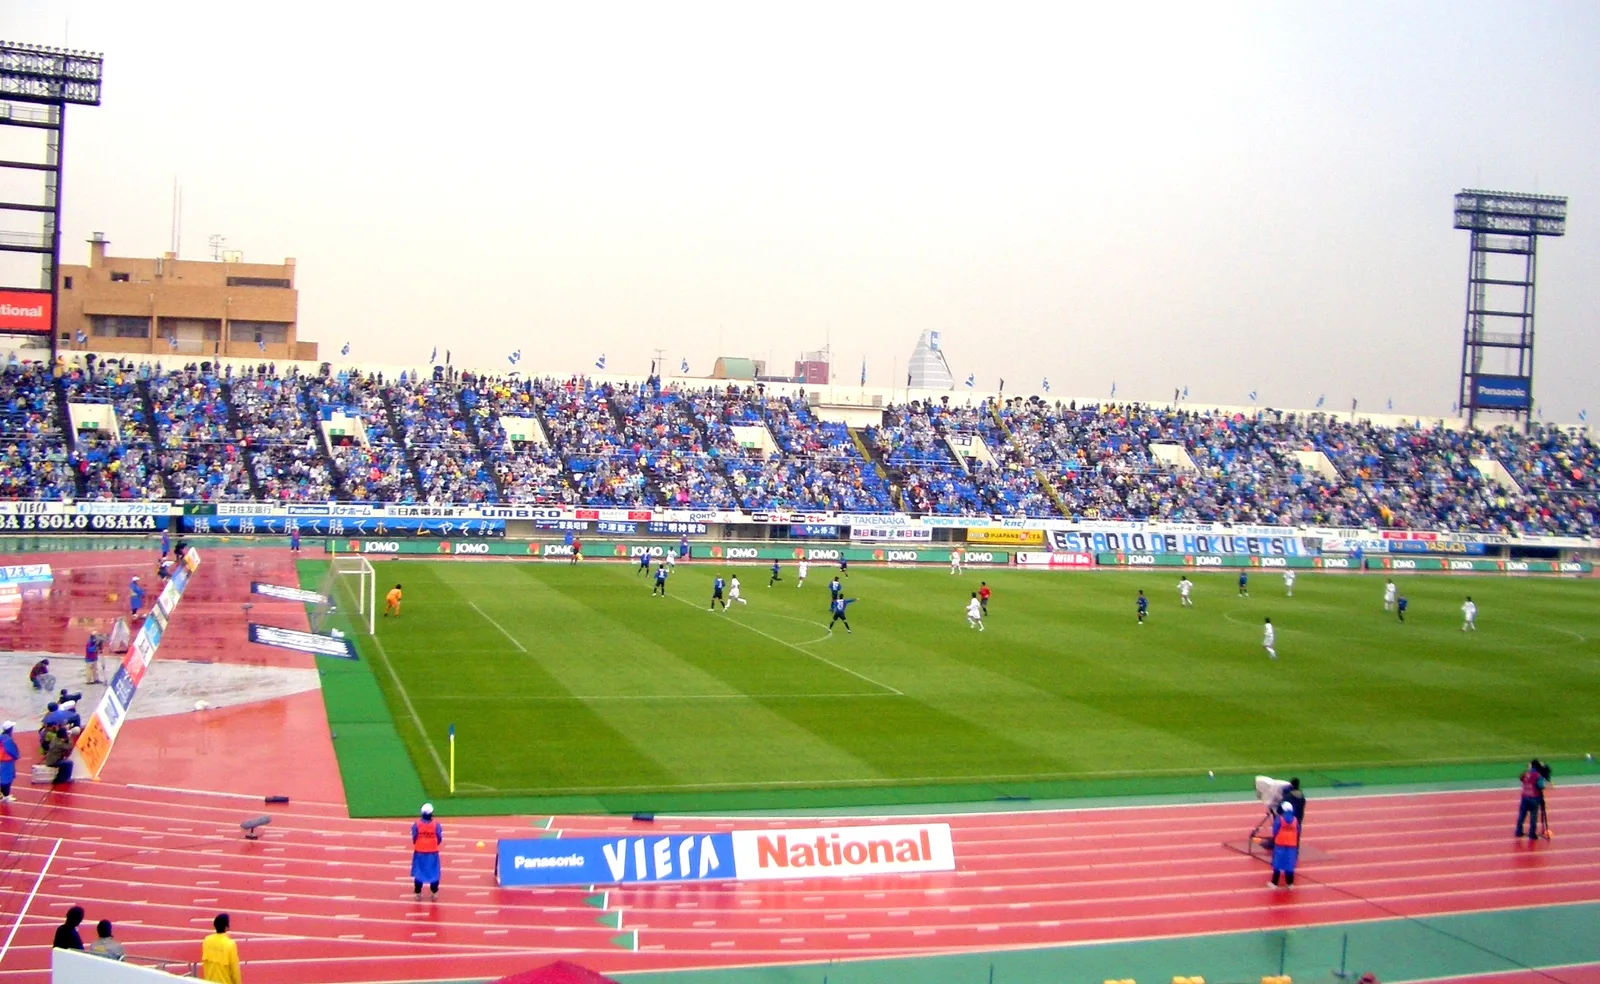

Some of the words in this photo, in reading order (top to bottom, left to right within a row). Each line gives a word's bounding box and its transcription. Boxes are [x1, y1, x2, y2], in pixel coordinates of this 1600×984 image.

[1479, 385, 1526, 397] Panasonic
[127, 504, 169, 514] アクトビラ
[219, 504, 272, 515] 三井住友銀行
[290, 506, 328, 514] PanaHome
[482, 509, 561, 518] UMBRO
[23, 515, 36, 529] E
[38, 514, 89, 529] SOLO
[92, 515, 157, 529] OSAKA
[690, 511, 717, 522] ROHTO
[853, 516, 906, 525] TAKENAKA
[668, 522, 706, 533] 明神智和
[922, 518, 954, 526] WOWOW
[958, 519, 989, 527] WOWOW
[853, 528, 887, 537] 朝日新聞
[896, 529, 930, 538] 朝日新聞
[364, 541, 400, 553] JOMO
[455, 543, 490, 554] JOMO
[1053, 532, 1147, 554] ESTADIO
[1151, 535, 1178, 554] DE
[1182, 535, 1299, 556] HOKUSETSU
[726, 548, 758, 559] JOMO
[808, 550, 839, 560] JOMO
[887, 551, 918, 561] JOMO
[964, 552, 993, 563] JOMO
[1054, 554, 1073, 563] Will
[1128, 555, 1155, 565] JOMO
[1196, 556, 1222, 566] JOMO
[1261, 557, 1287, 567] JOMO
[1324, 558, 1349, 568] JOMO
[1392, 559, 1416, 569] JOMO
[514, 854, 585, 869] Panasonic
[756, 829, 932, 869] National
